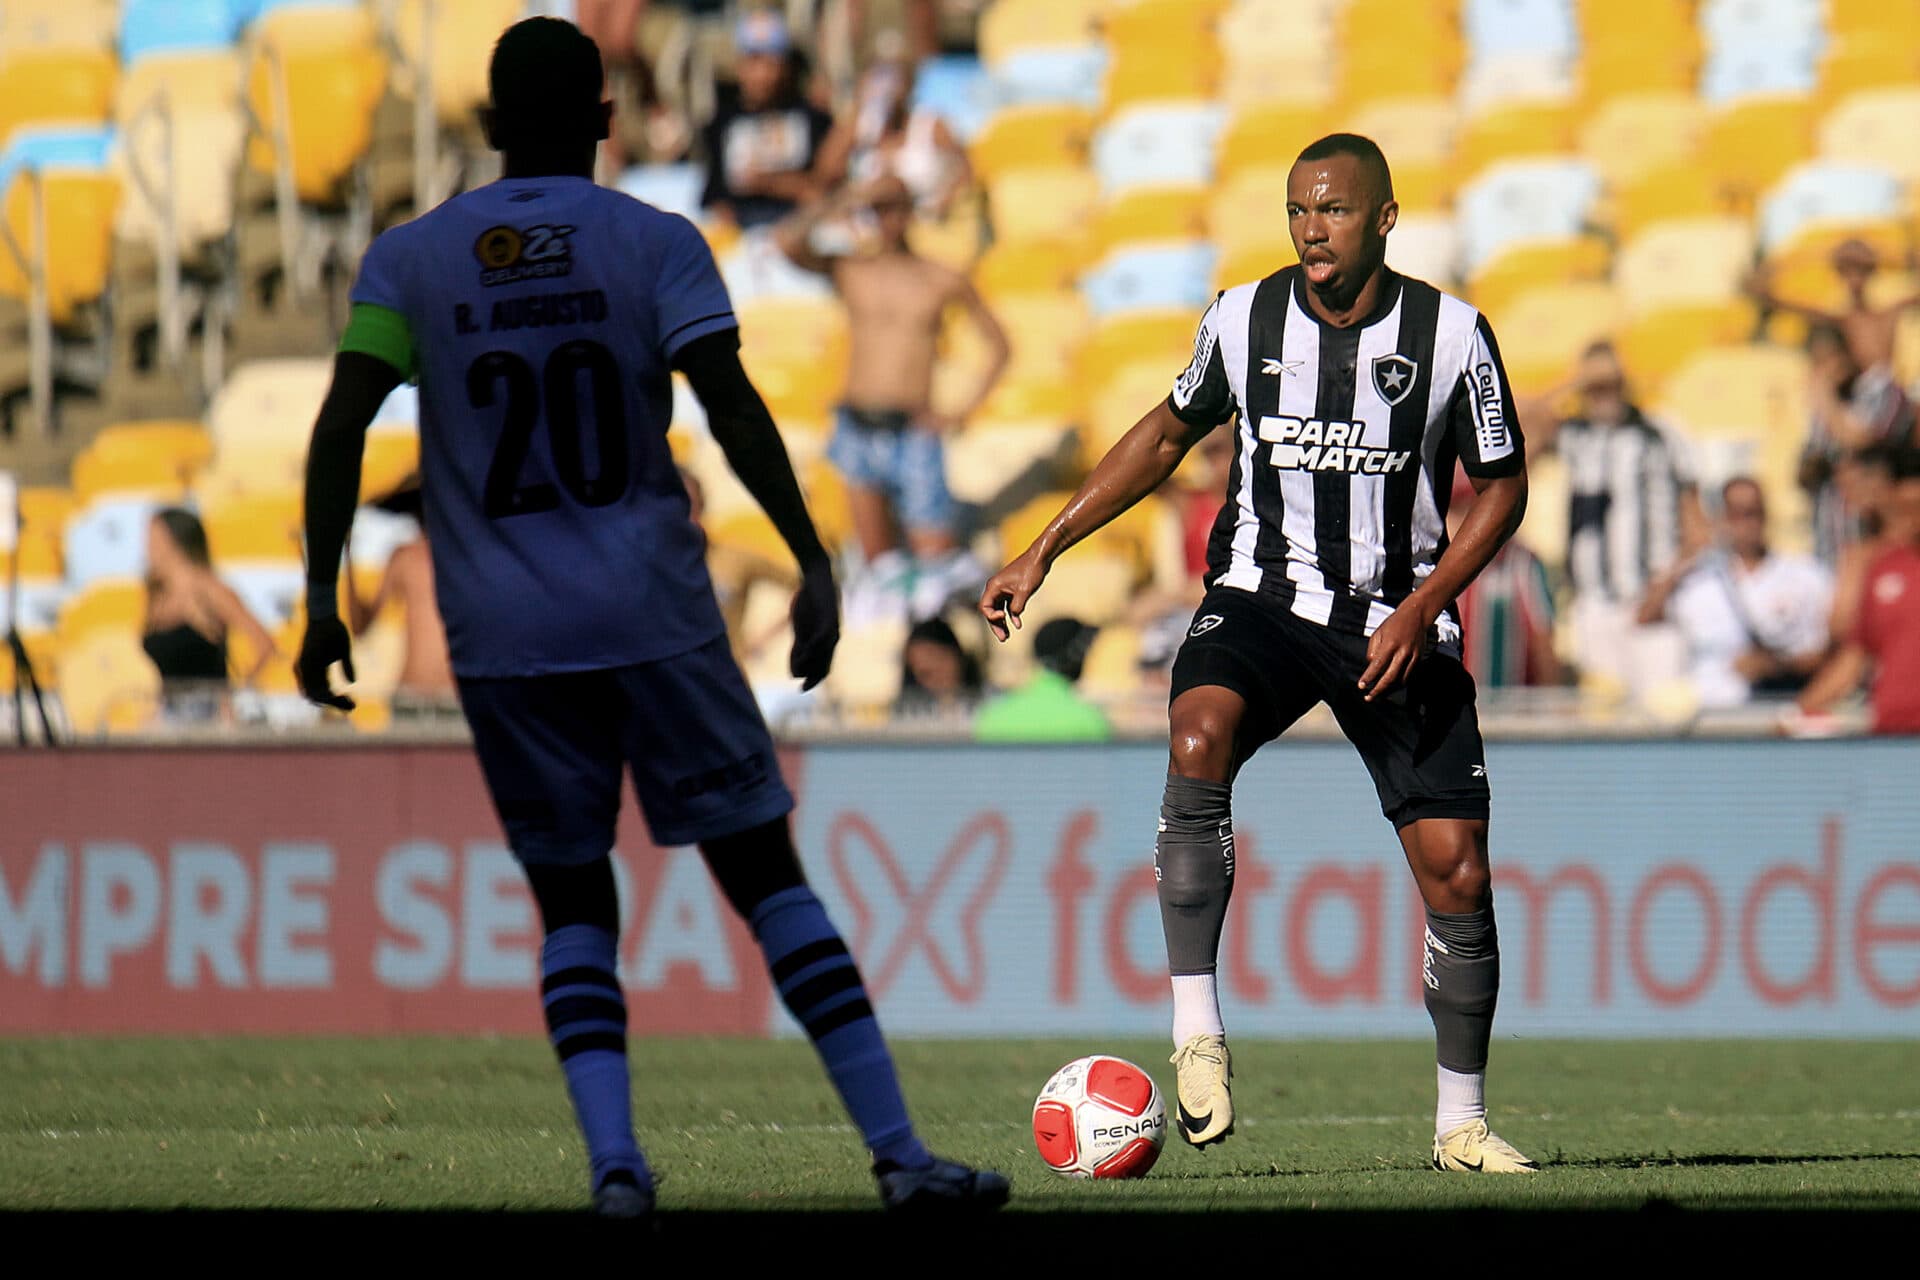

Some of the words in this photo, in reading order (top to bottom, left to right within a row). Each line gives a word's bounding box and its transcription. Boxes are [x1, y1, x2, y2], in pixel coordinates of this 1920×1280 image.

[480, 261, 570, 286] DELIVERY
[454, 303, 480, 335] R.
[491, 289, 608, 331] AUGUSTO
[1475, 362, 1507, 448] Centrum
[468, 340, 628, 518] 20
[1259, 416, 1363, 448] PARI
[1270, 444, 1411, 473] MATCH
[0, 840, 334, 989] MPRE
